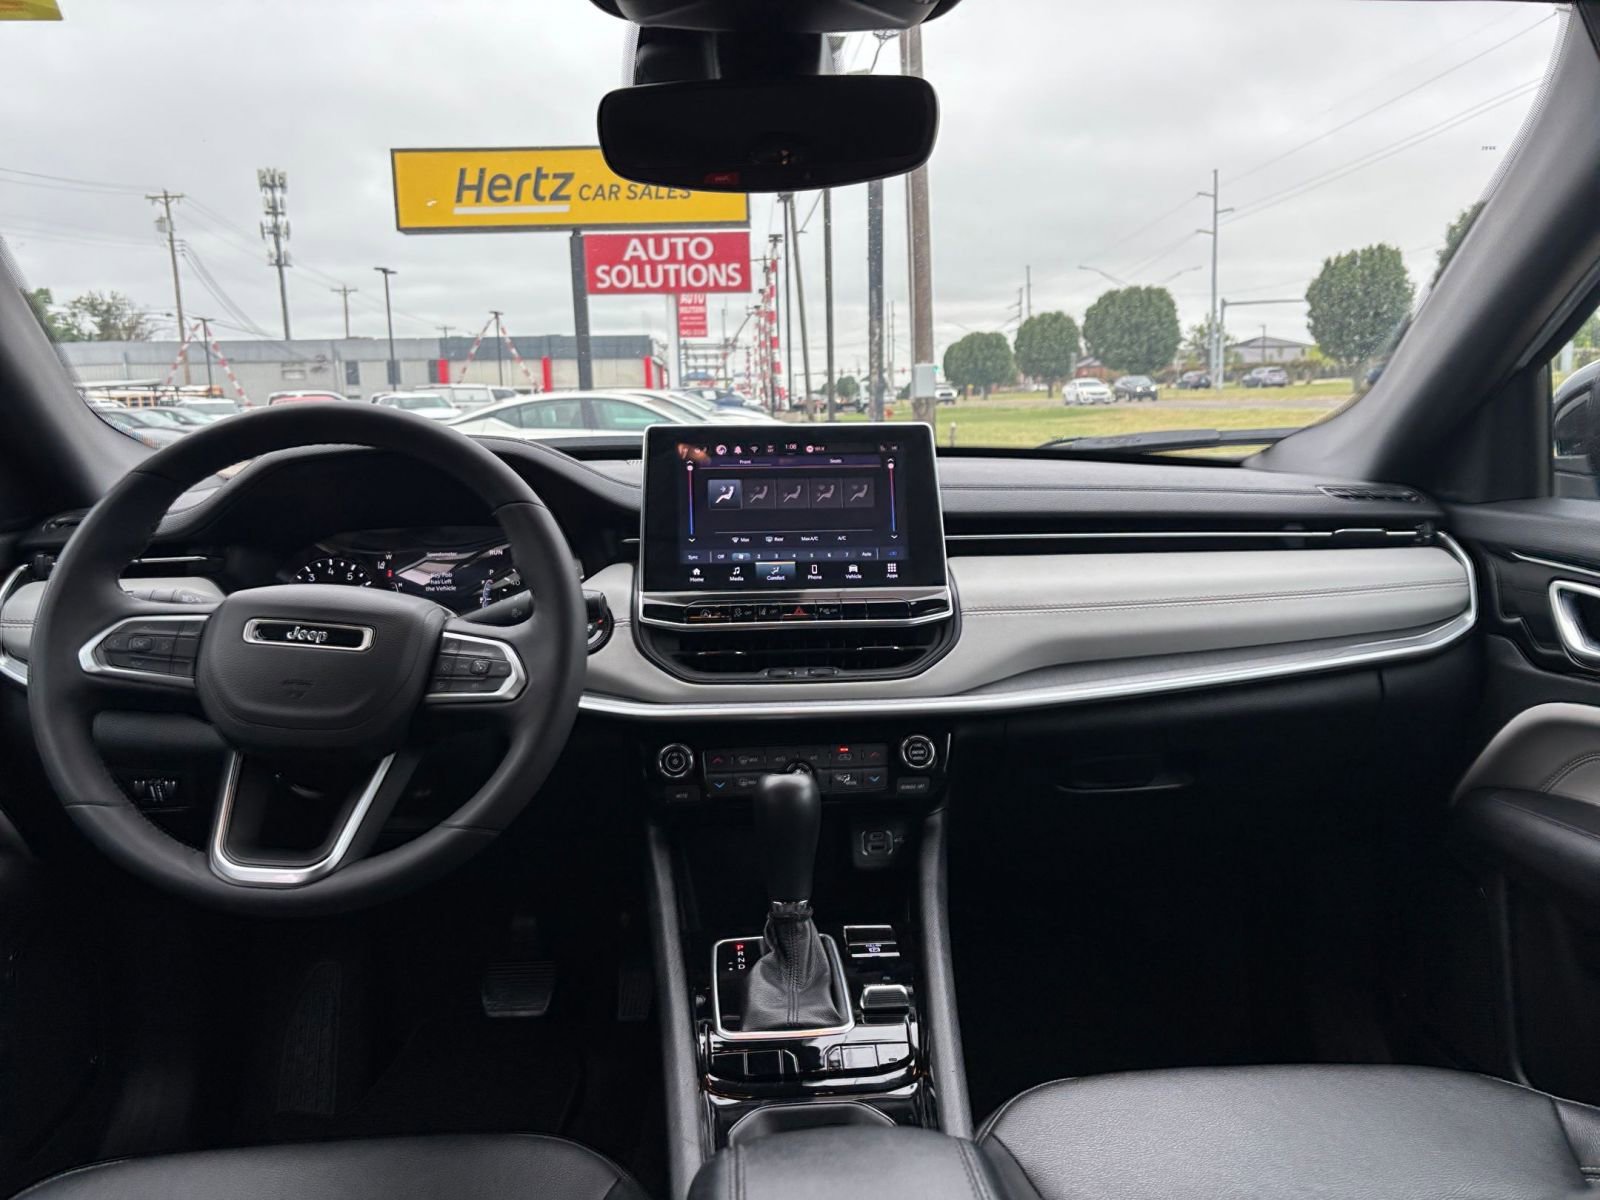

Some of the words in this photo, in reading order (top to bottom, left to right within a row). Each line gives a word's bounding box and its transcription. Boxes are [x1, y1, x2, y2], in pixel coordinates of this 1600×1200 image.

[454, 167, 575, 204] Hertz
[579, 184, 621, 201] CAR
[623, 237, 714, 261] AUTO
[595, 263, 742, 289] SOLUTIONS
[308, 573, 316, 582] 3
[328, 566, 334, 575] 4
[347, 572, 354, 581] 5
[286, 626, 328, 643] Jeep
